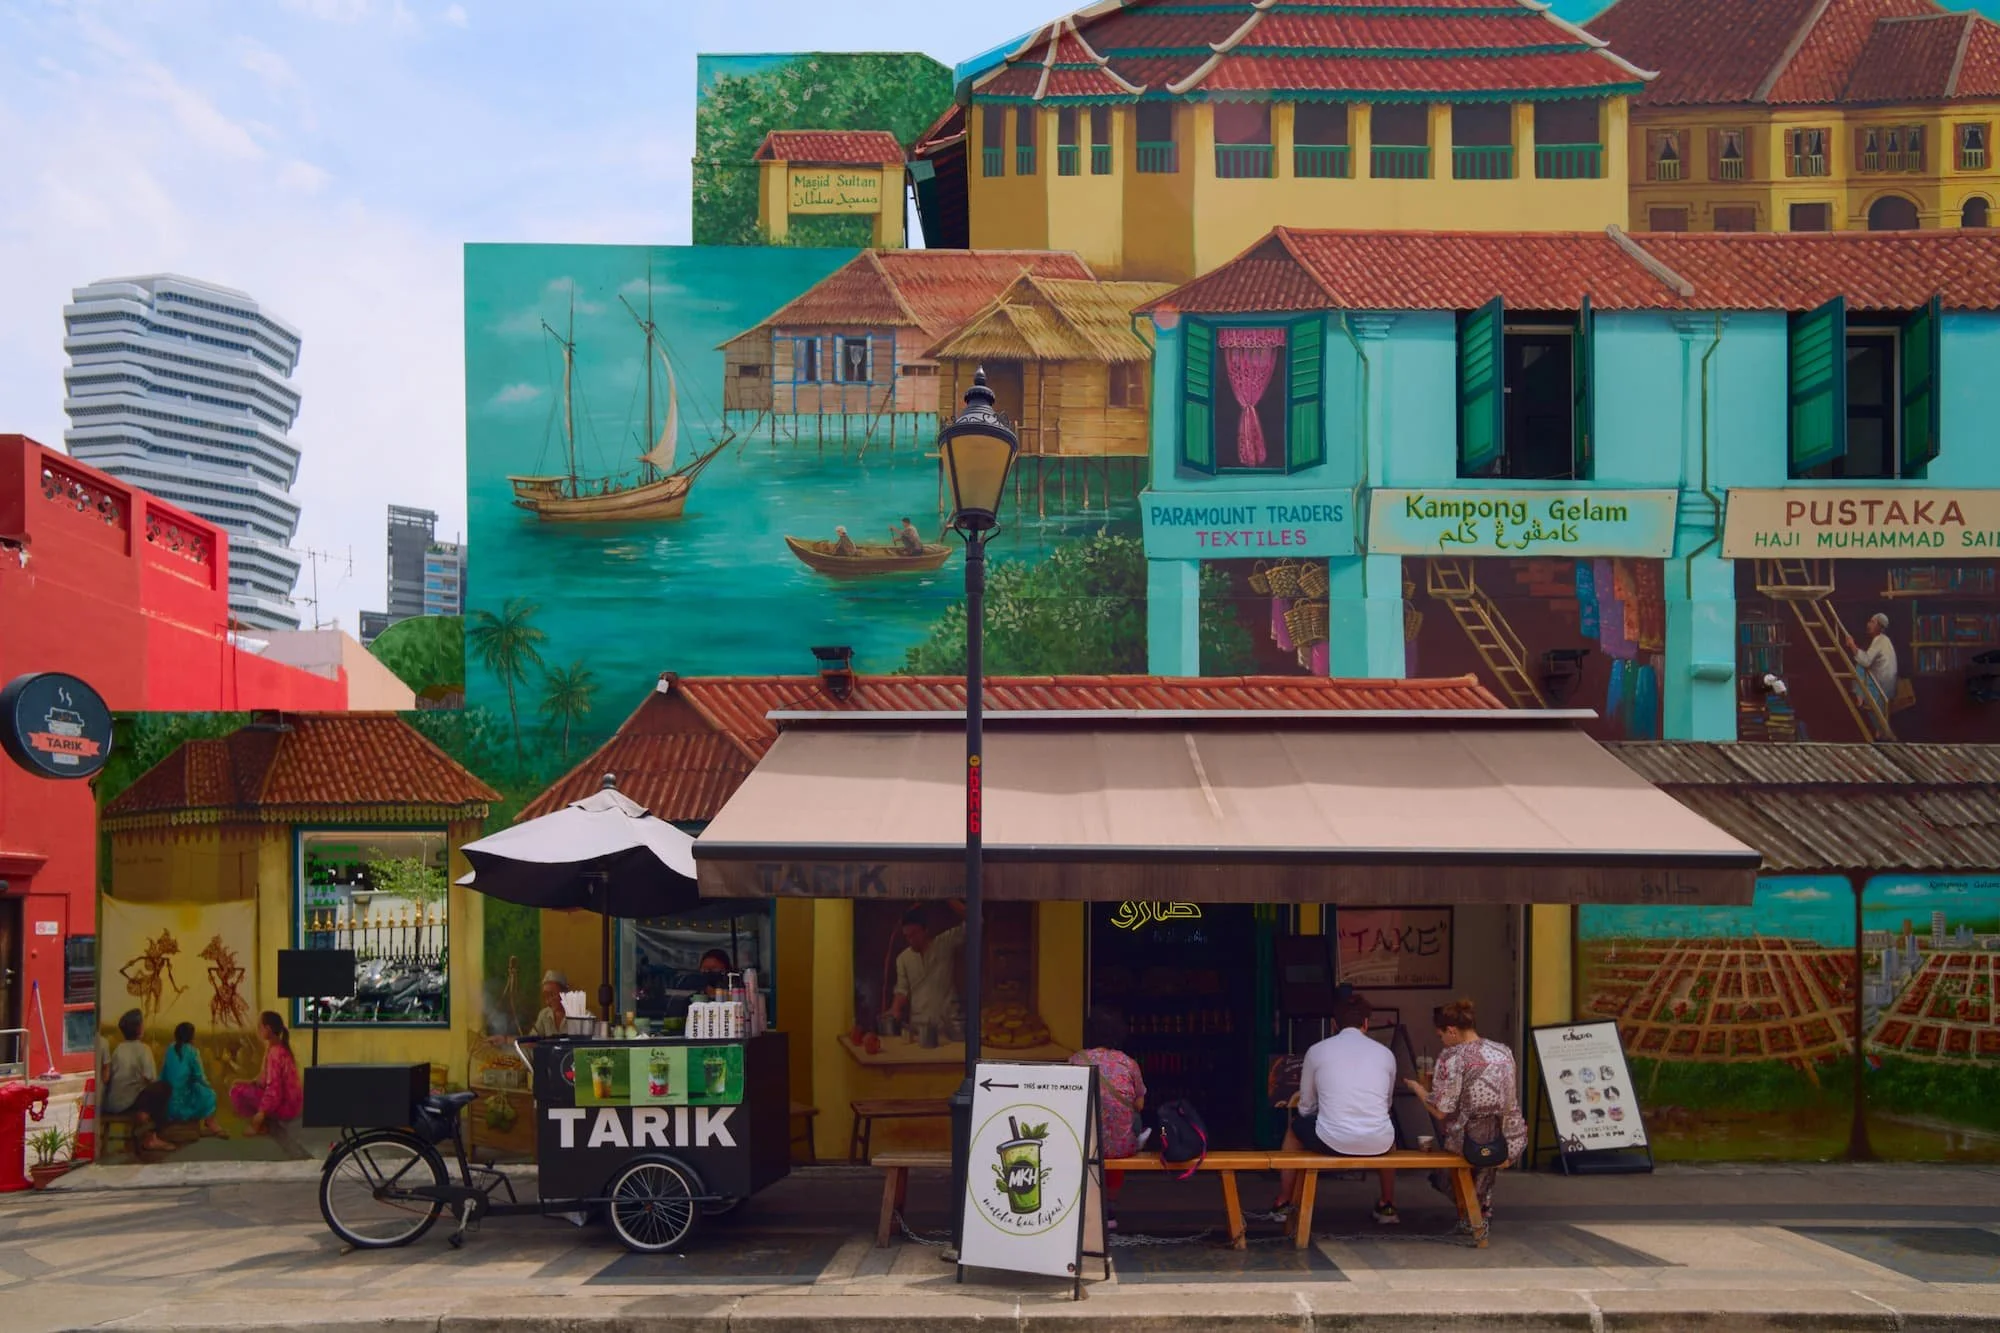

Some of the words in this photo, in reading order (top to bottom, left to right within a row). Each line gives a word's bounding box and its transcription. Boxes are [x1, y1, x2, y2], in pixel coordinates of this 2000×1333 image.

[794, 174, 830, 190] Masjid
[836, 174, 876, 187] Sultan
[1151, 505, 1257, 526] PARAMOUNT
[1266, 504, 1344, 524] TRADERS
[1405, 495, 1528, 525] Kampong
[1548, 496, 1628, 522] Gelam
[1785, 499, 1966, 526] PUSTAKA
[1196, 529, 1307, 548] TEXTILES
[1754, 531, 1800, 548] HAJI
[1817, 530, 1945, 548] MUHAMMAD
[47, 736, 83, 751] TARIK
[756, 862, 888, 895] TARIK
[1059, 1084, 1083, 1092] MATCHA
[548, 1107, 737, 1148] TARIK
[1008, 1167, 1039, 1188] MKH
